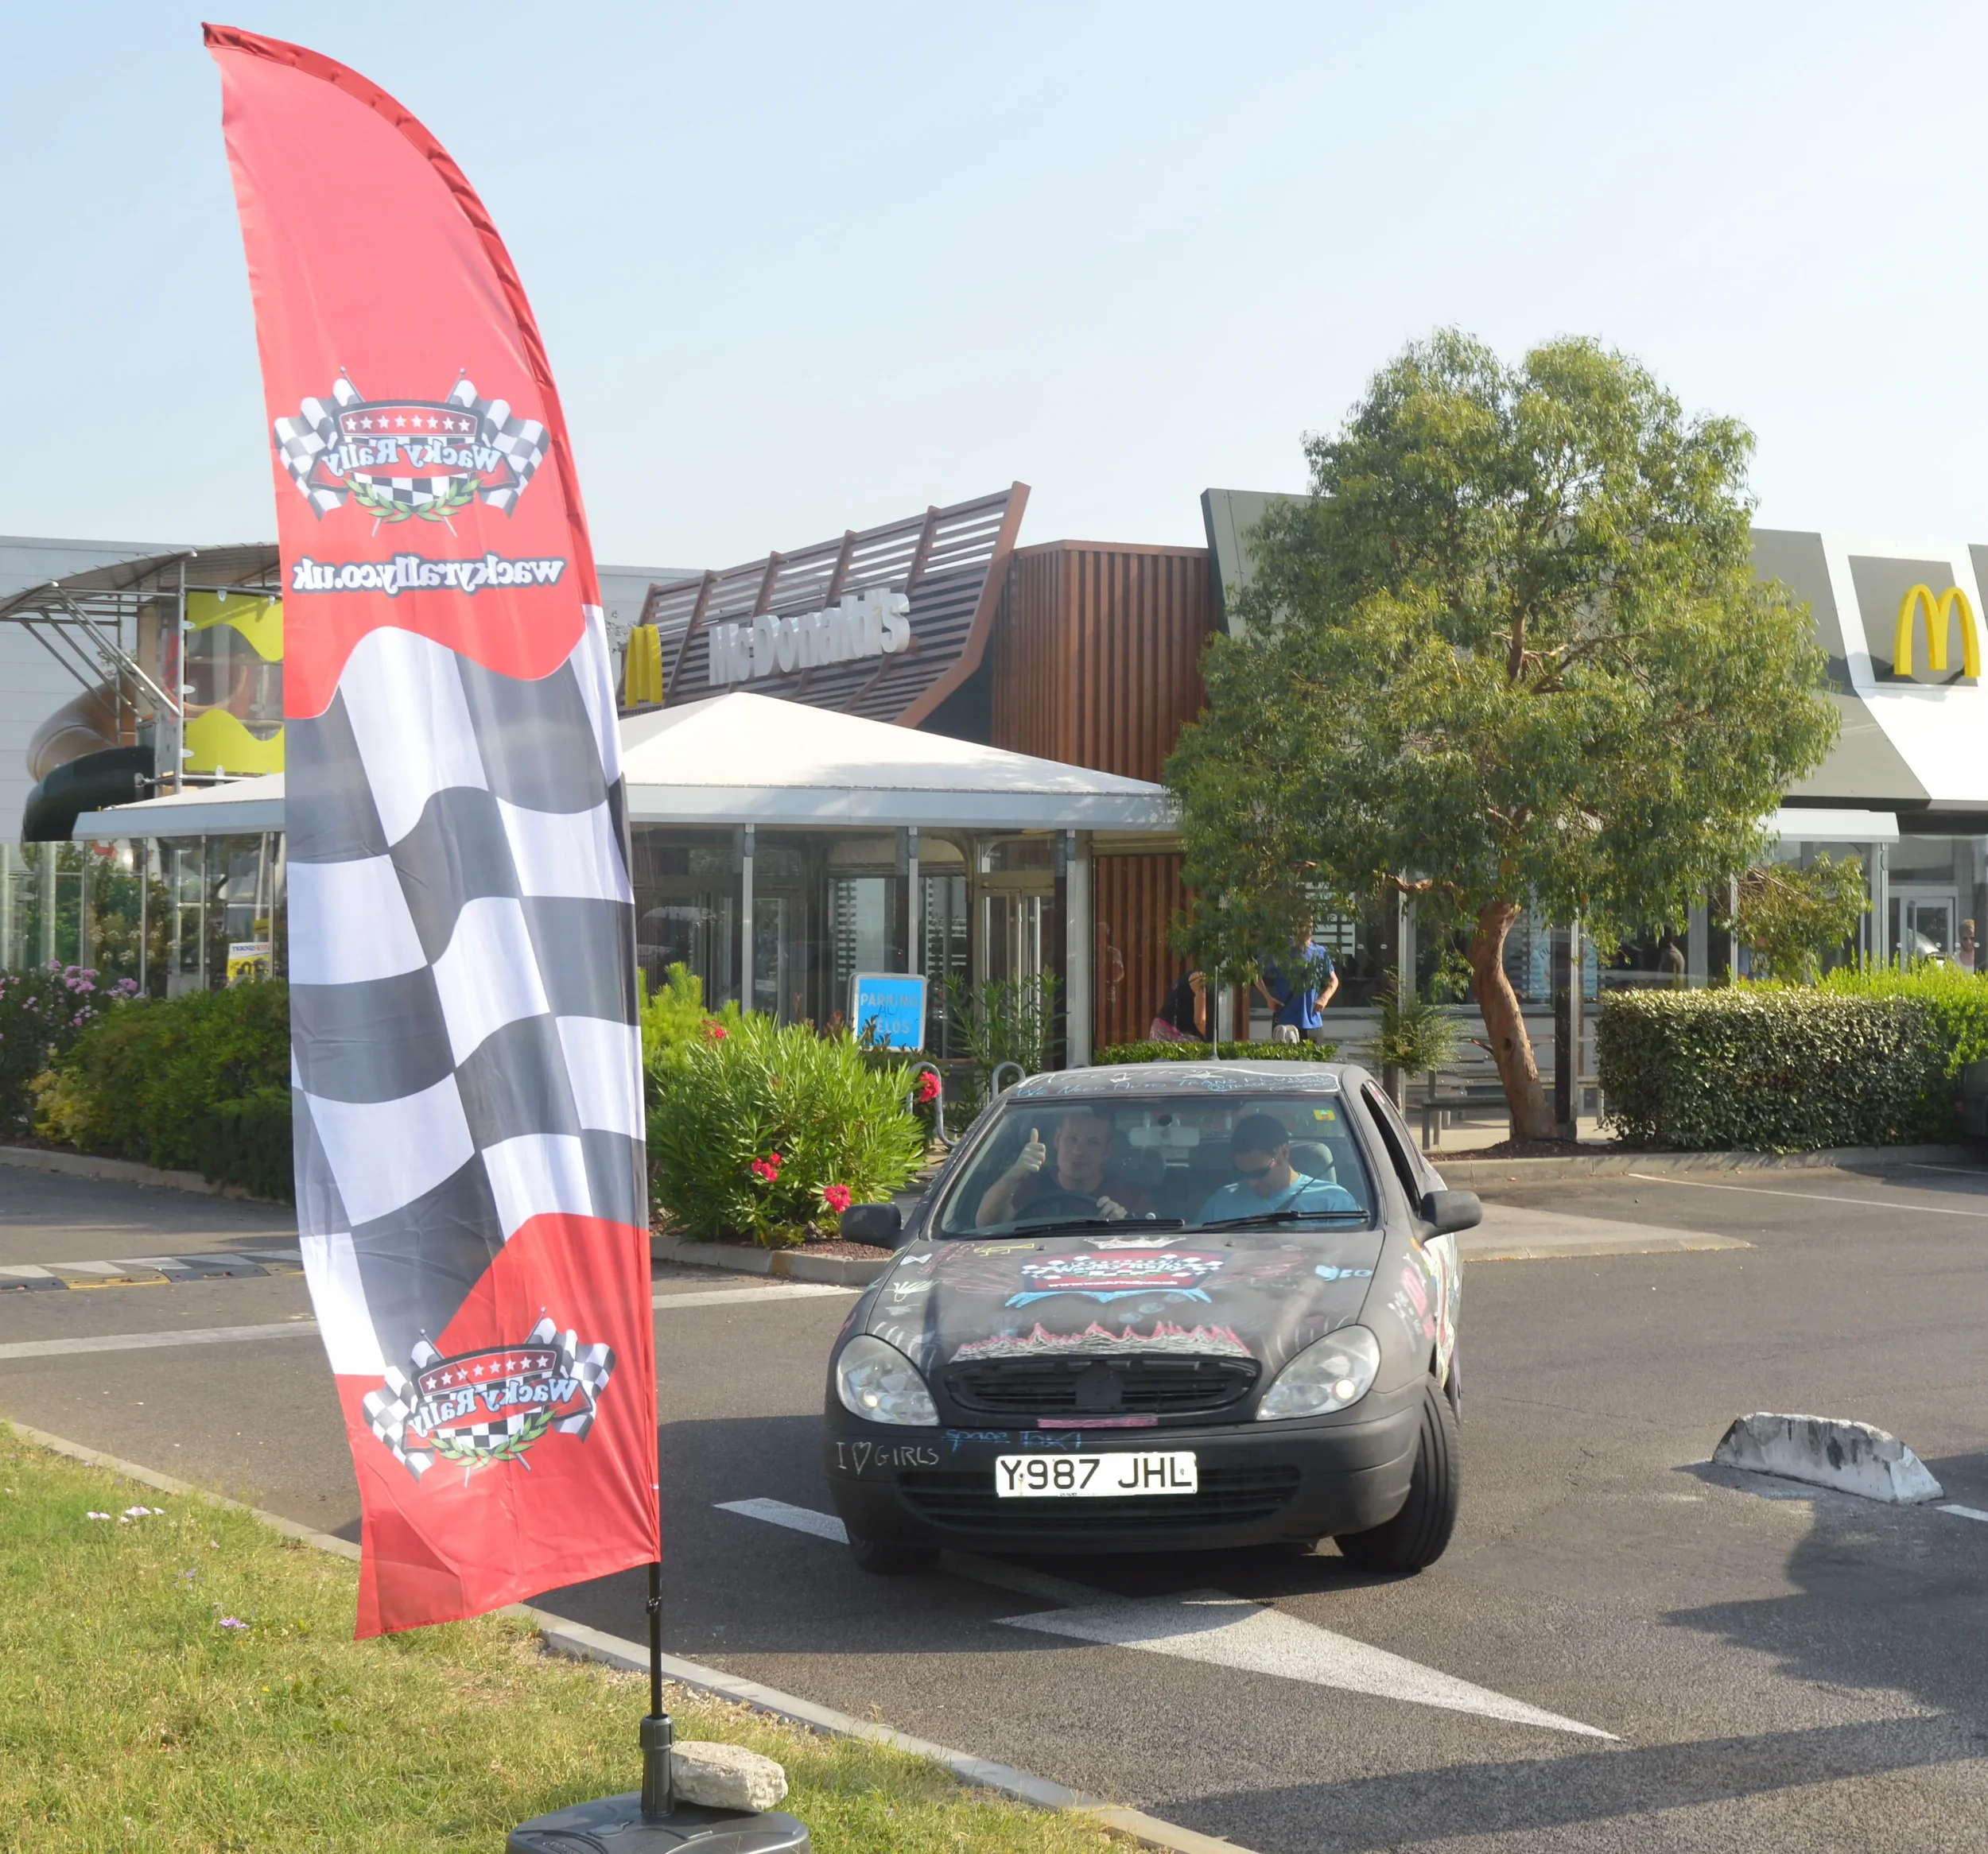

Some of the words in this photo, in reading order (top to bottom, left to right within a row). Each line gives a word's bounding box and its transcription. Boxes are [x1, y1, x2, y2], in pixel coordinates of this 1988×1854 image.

[709, 588, 911, 686] McDonald's
[860, 993, 918, 1007] PARKING
[871, 1017, 911, 1034] ÉLOS
[836, 1441, 847, 1469] I
[875, 1445, 939, 1468] GIRLS
[1000, 1458, 1101, 1491] Y987
[1117, 1456, 1192, 1489] JHL
